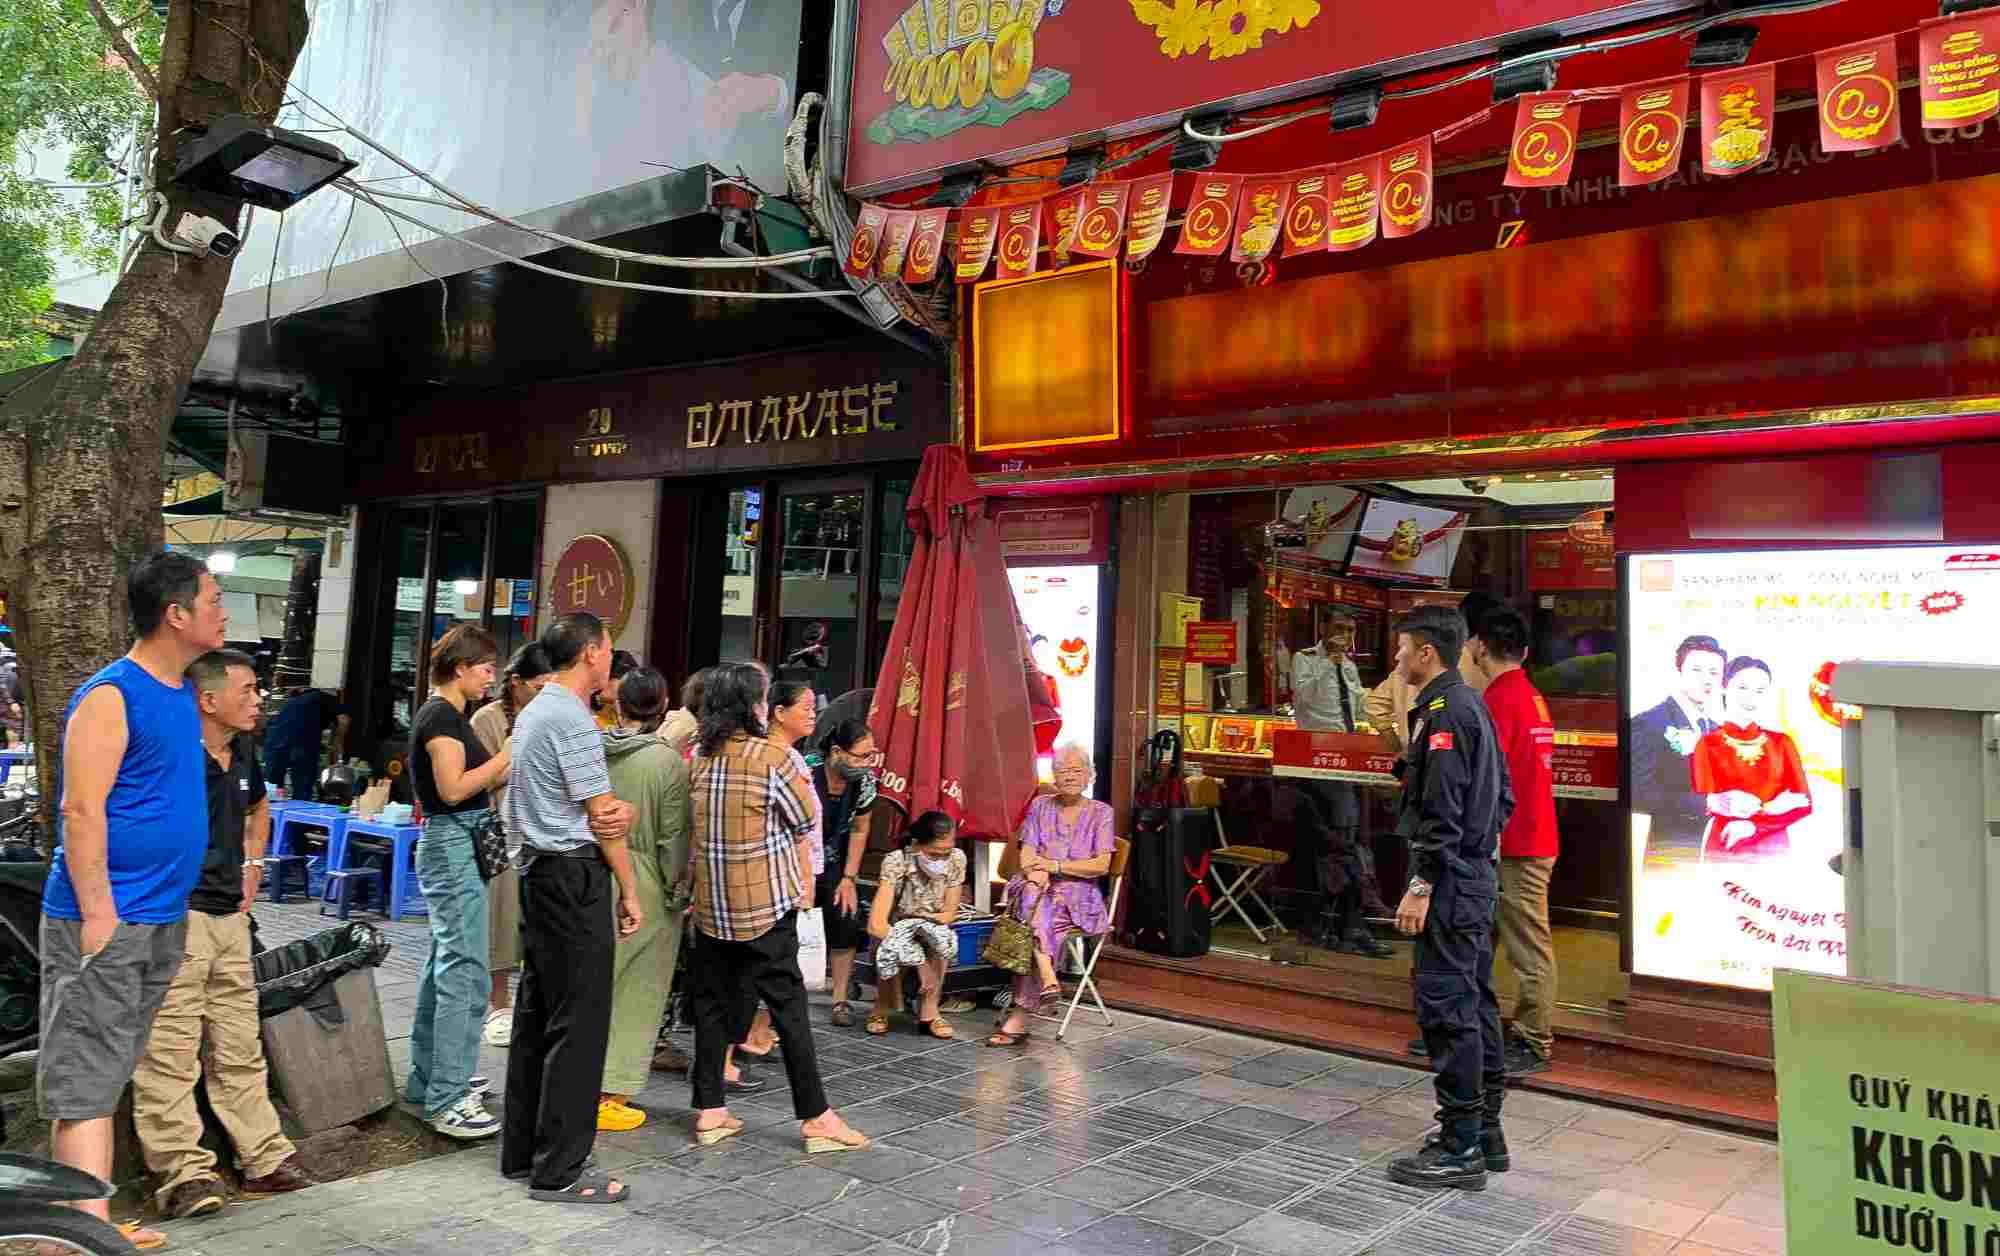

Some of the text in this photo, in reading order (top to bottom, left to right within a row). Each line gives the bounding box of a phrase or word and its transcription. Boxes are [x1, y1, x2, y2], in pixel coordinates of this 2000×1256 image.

[1486, 190, 1528, 217] TY
[1540, 172, 1628, 209] TNHH
[686, 380, 899, 449] OMAKASE
[566, 562, 614, 608] 甘い
[1849, 1073, 1912, 1113] QUÝ
[1855, 1197, 1950, 1256] DƯỚI
